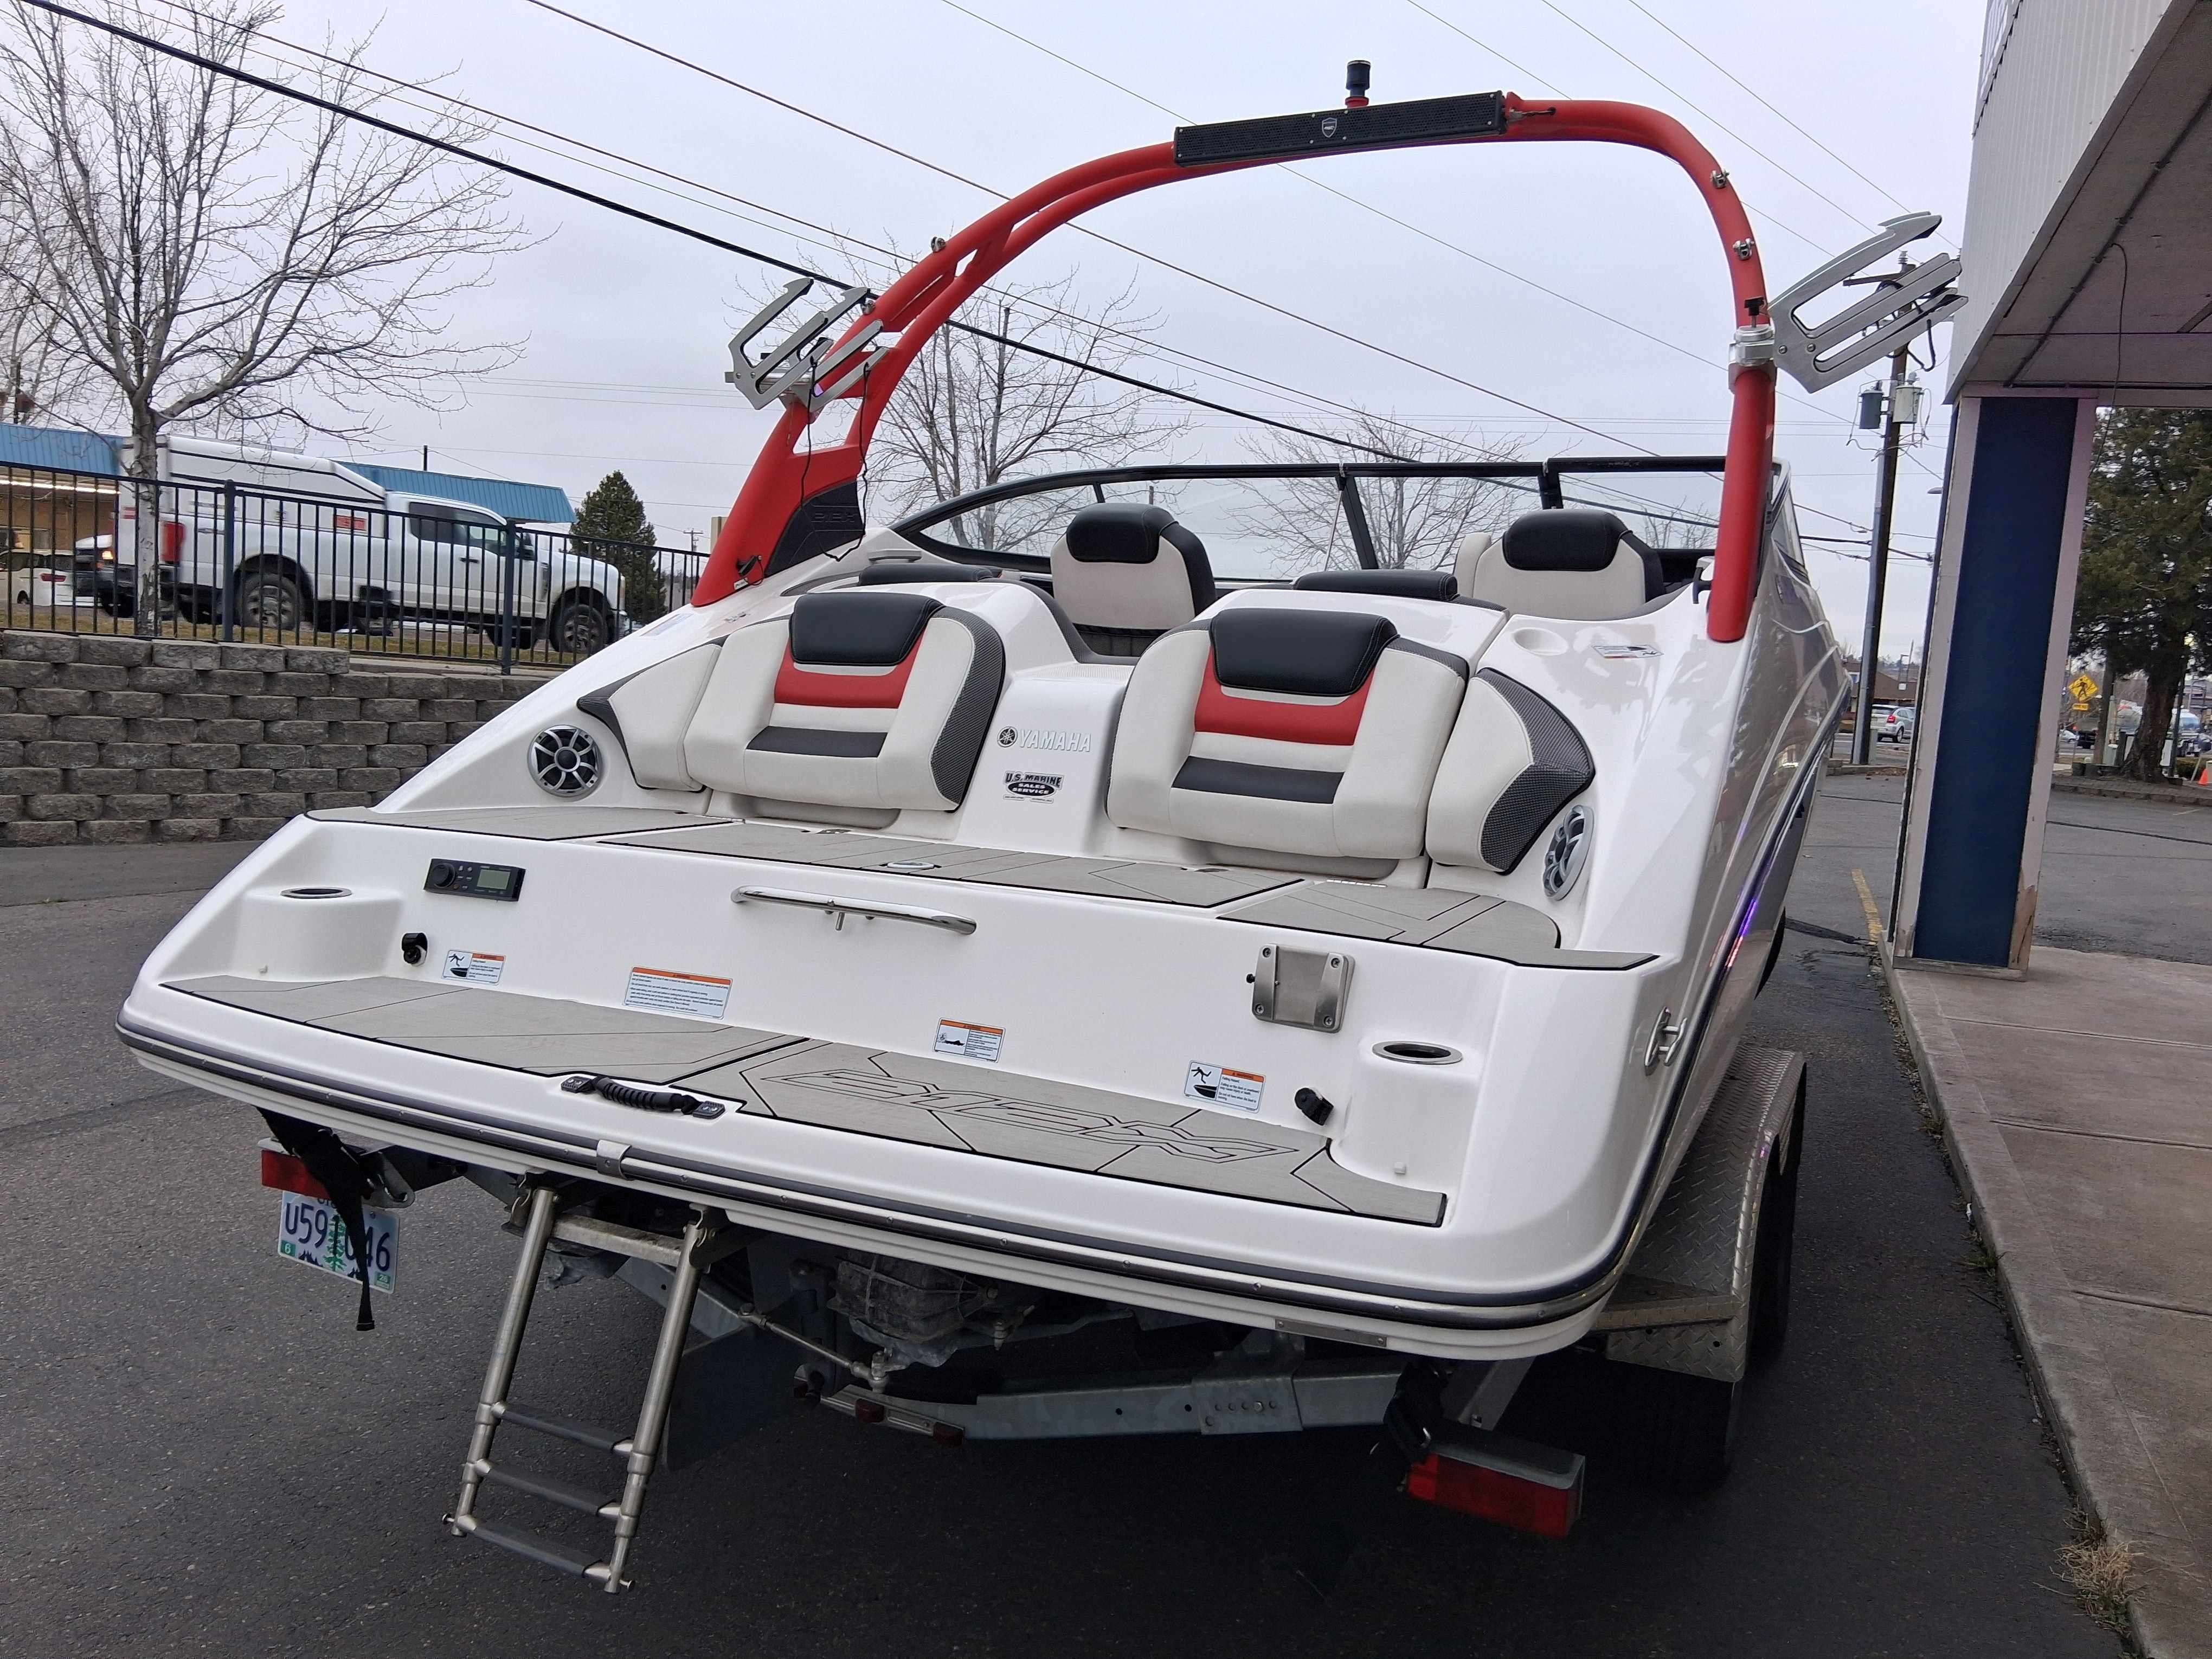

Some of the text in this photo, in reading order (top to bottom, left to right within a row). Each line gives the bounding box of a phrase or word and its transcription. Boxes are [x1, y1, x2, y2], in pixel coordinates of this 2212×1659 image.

[1020, 729, 1091, 753] YAMAHA
[1005, 773, 1063, 787] U.S. MARINE
[285, 1244, 292, 1254] 6
